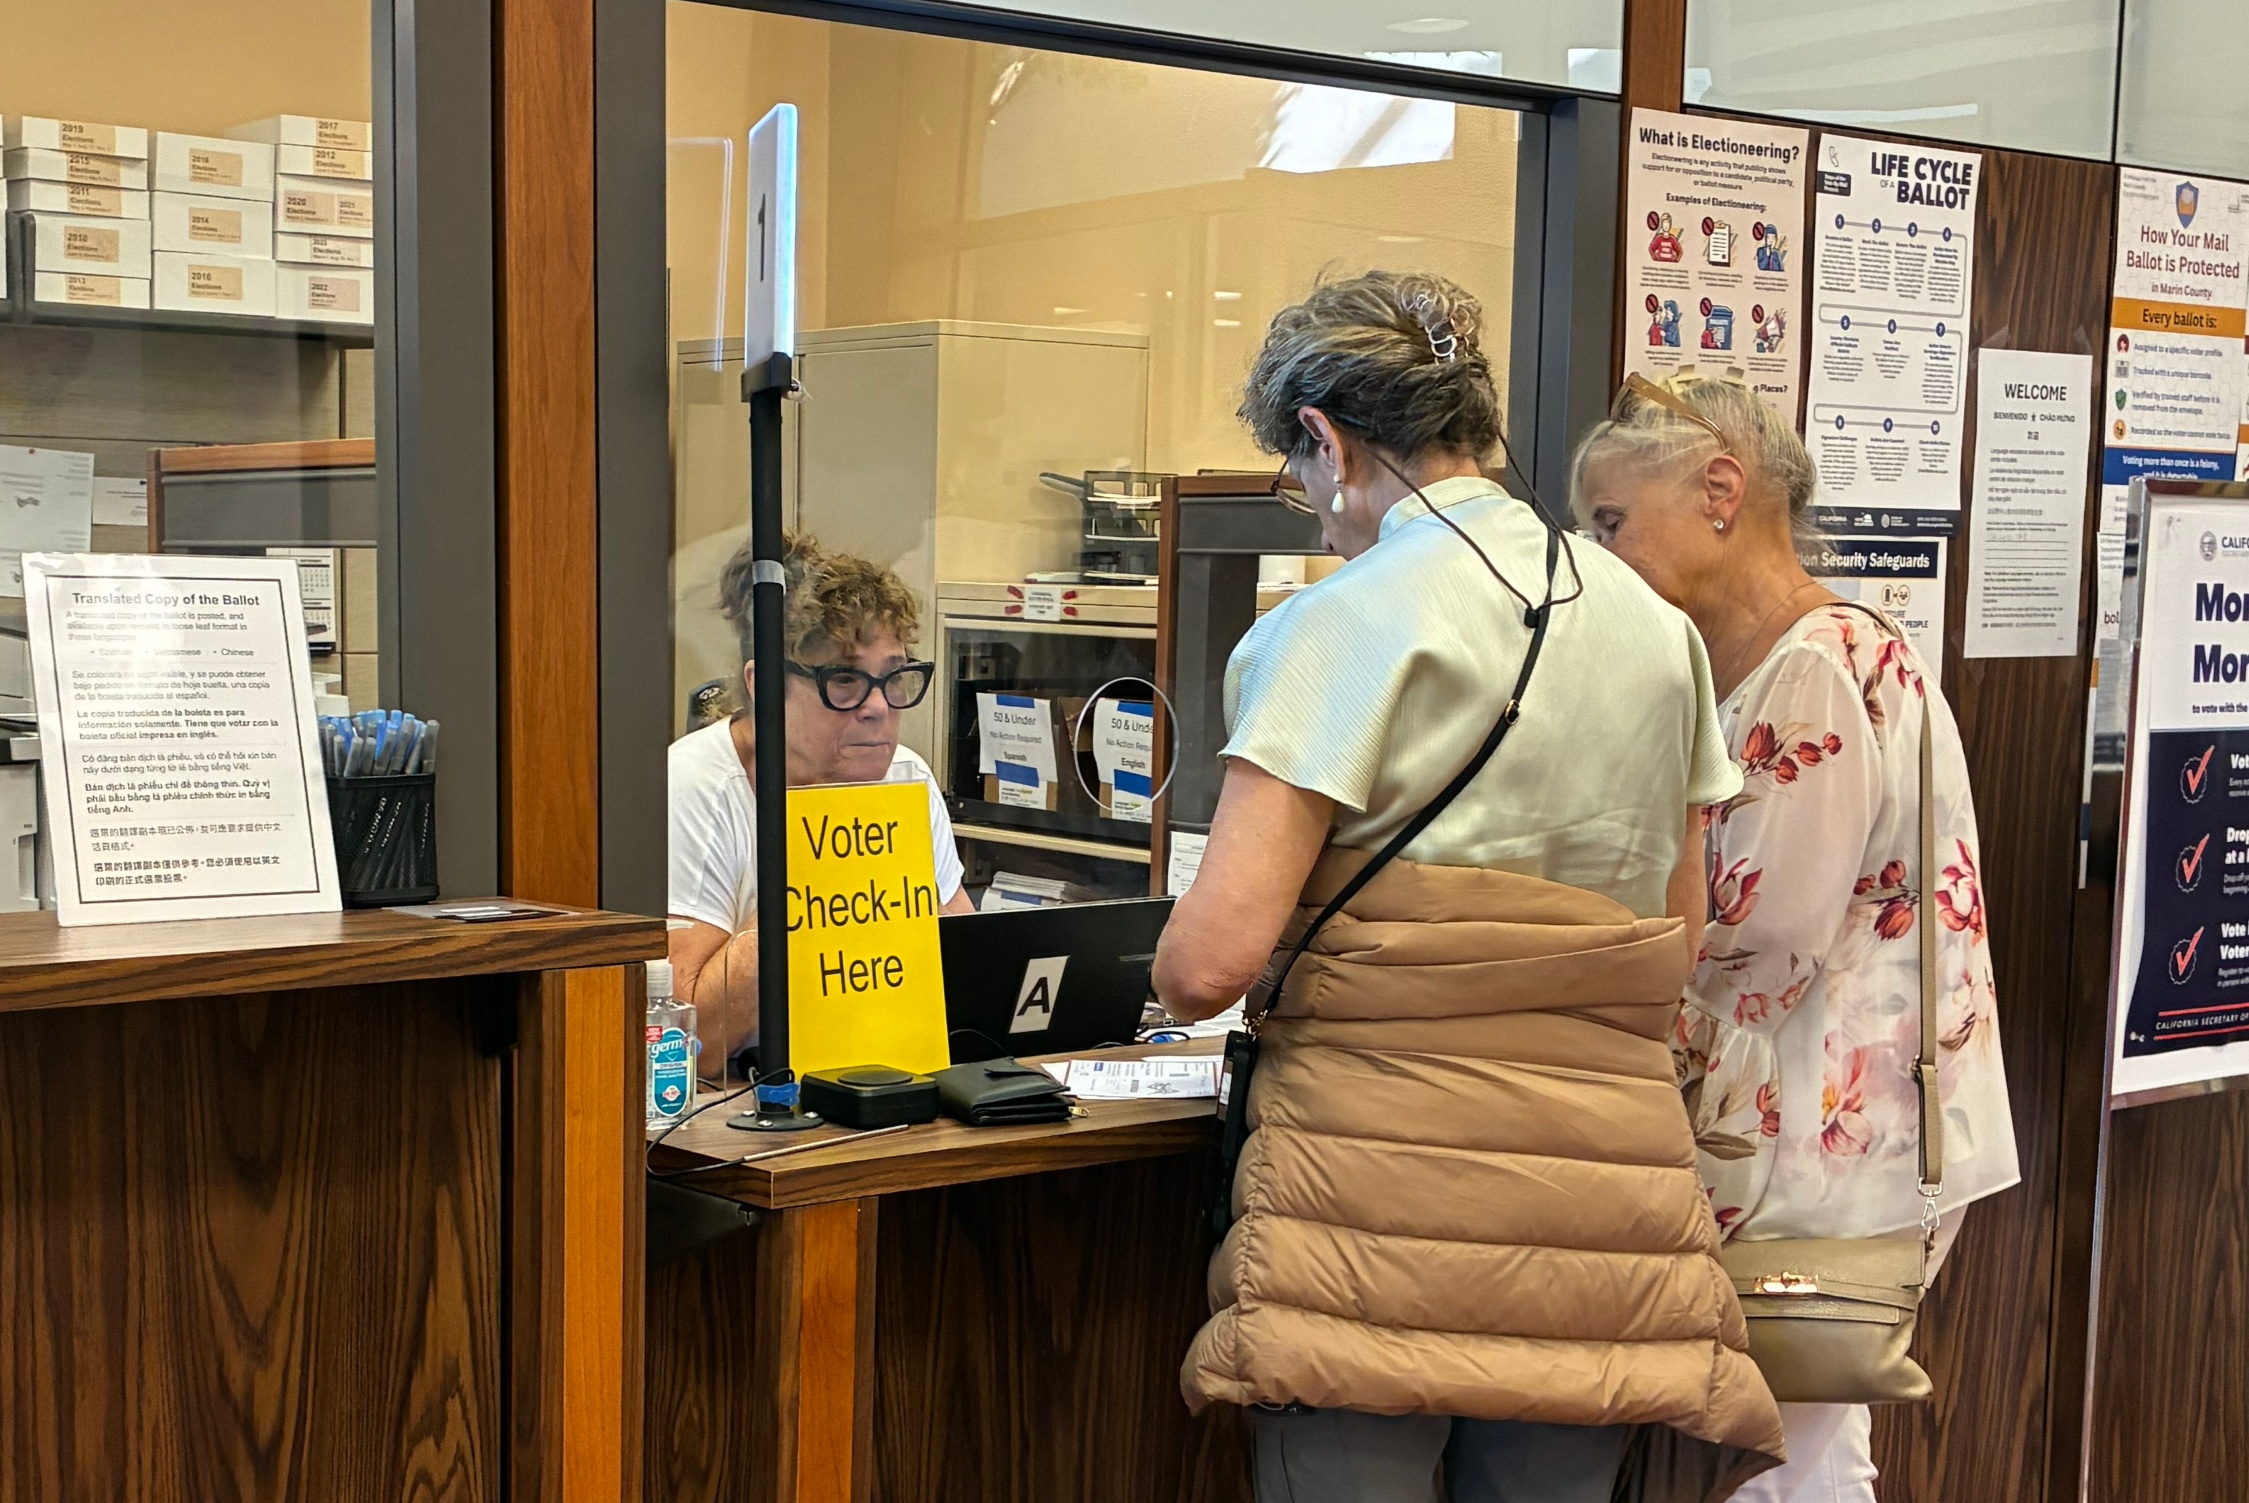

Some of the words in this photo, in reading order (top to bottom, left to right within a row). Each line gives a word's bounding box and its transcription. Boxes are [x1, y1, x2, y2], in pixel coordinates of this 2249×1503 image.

[62, 124, 83, 133] 2019
[318, 121, 338, 130] 2017
[1640, 127, 1674, 146] What
[1678, 131, 1688, 147] is
[1692, 134, 1800, 164] Electioneering?
[316, 150, 336, 159] 2012
[1871, 152, 1909, 178] LIFE
[1914, 158, 1973, 186] CYCLE
[70, 187, 89, 195] 2011
[1896, 181, 1970, 210] BALLOT
[1666, 193, 1701, 205] Examples
[1703, 197, 1710, 205] of
[757, 193, 766, 281] 1
[2141, 225, 2168, 245] How
[2171, 228, 2200, 247] Your
[2203, 233, 2229, 252] Mail
[2127, 250, 2162, 271] Ballot
[2165, 254, 2176, 272] is
[2179, 256, 2240, 279] Protected
[2152, 282, 2159, 293] in
[2160, 283, 2183, 296] Marin
[2184, 286, 2212, 300] County
[2142, 309, 2172, 328] Every
[2174, 311, 2203, 327] ballot
[1760, 384, 1788, 394] Places?
[2004, 383, 2067, 401] WELCOME
[1821, 552, 1868, 570] Security
[1869, 552, 1930, 570] Safeguards
[72, 592, 141, 604] Translated
[145, 593, 178, 607] Copy
[183, 594, 195, 605] of
[199, 595, 219, 605] the
[223, 595, 260, 606] Ballot
[1906, 620, 1928, 628] PEOPLE
[91, 710, 115, 718] copia
[117, 709, 160, 717] traducida
[226, 709, 245, 717] para
[2192, 704, 2200, 713] to
[2202, 704, 2217, 713] vote
[2219, 703, 2235, 713] with
[2236, 703, 2248, 713] the
[210, 720, 226, 728] que
[1012, 714, 1036, 725] Under
[1111, 718, 1122, 729] 50
[1124, 720, 1130, 730] &
[139, 731, 174, 740] impresa
[1106, 738, 1114, 746] No
[1116, 739, 1135, 749] Action
[1004, 751, 1027, 761] Spanish
[1122, 758, 1146, 769] English
[802, 814, 898, 860] Voter
[2225, 850, 2237, 864] at
[2238, 851, 2245, 863] a
[786, 876, 934, 932] Check-In
[2221, 923, 2246, 938] Vote
[819, 950, 904, 996] Here
[1016, 976, 1050, 1016] A
[2156, 1019, 2199, 1030] CALIFORNIA
[2202, 1014, 2238, 1026] SECRETARY
